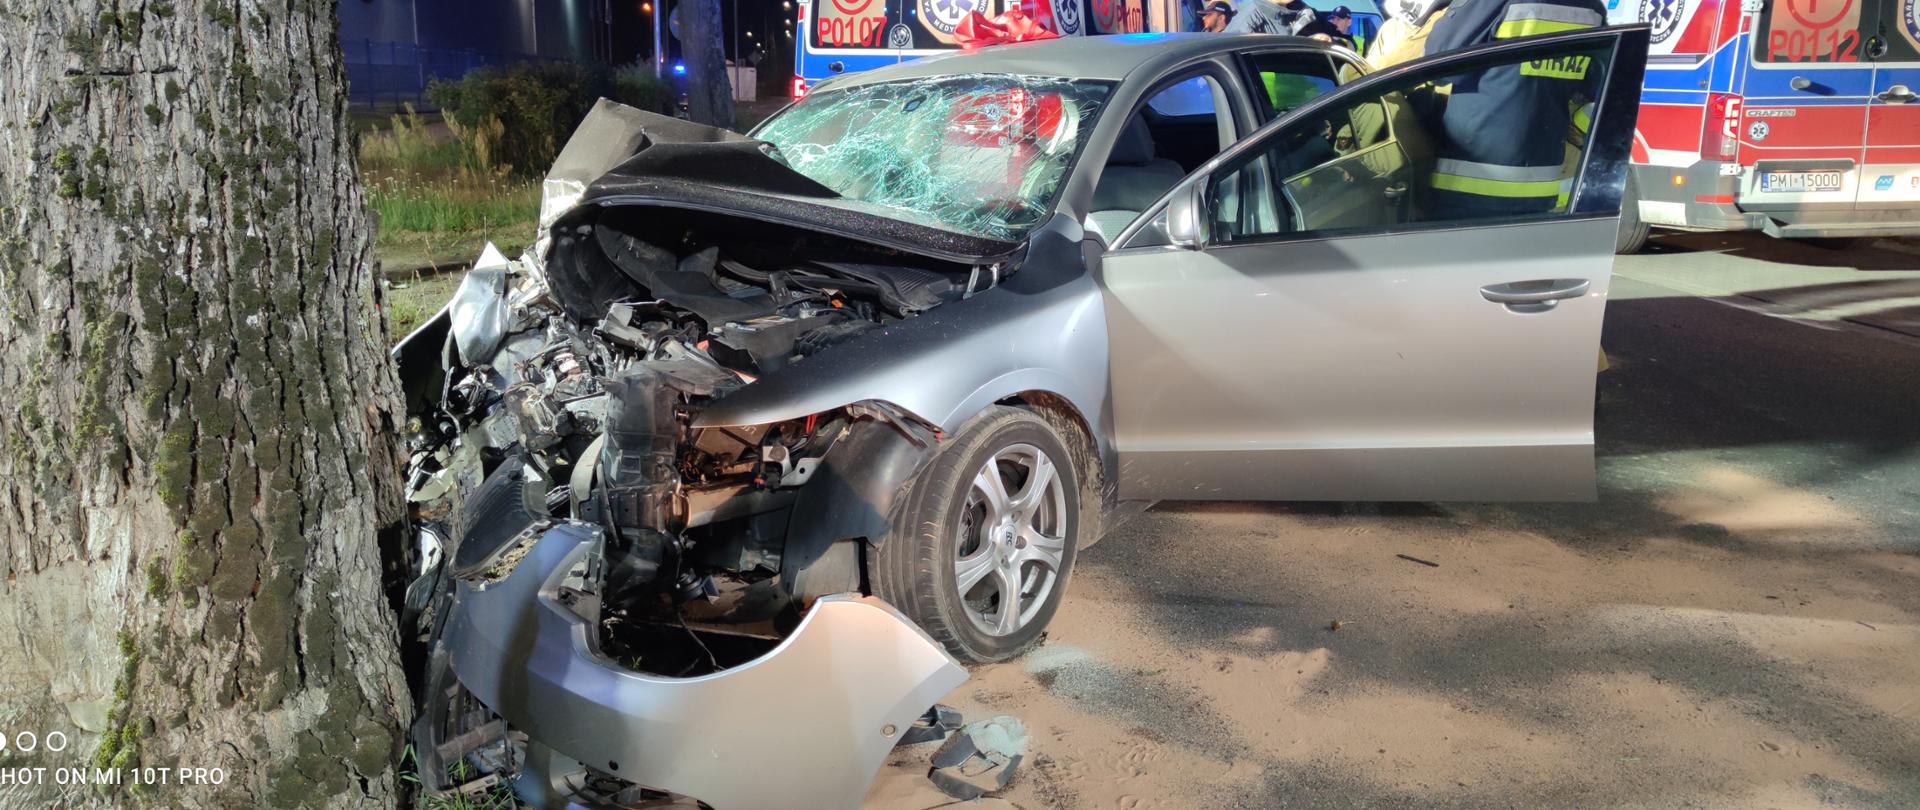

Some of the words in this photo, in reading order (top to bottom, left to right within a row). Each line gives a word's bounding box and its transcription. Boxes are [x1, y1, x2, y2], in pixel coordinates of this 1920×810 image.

[818, 17, 888, 47] P0107
[933, 19, 955, 33] MEDY
[1768, 29, 1860, 63] P0112
[1770, 174, 1792, 187] PMI
[1800, 174, 1839, 187] 15000
